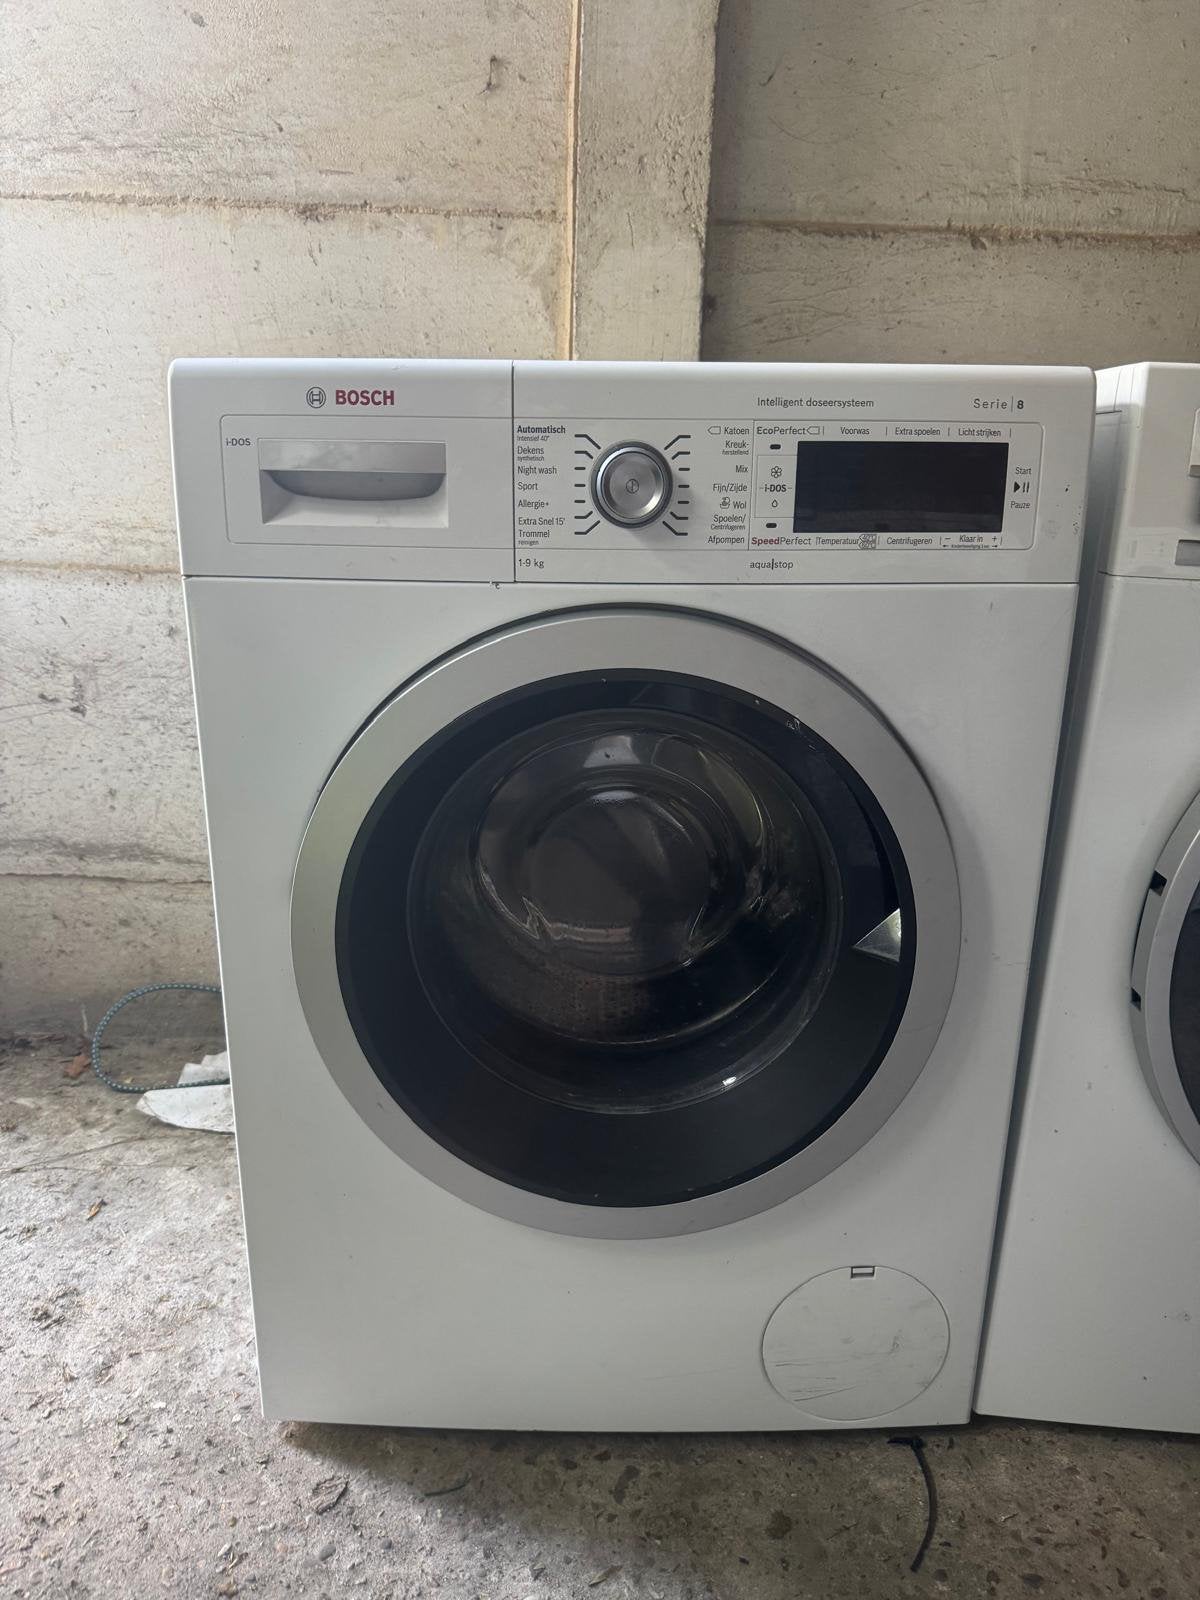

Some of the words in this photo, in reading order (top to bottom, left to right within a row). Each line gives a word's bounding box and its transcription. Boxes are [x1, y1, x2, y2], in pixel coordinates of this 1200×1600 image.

[335, 389, 395, 406] BOSCH
[757, 396, 804, 409] Intelligent
[805, 397, 874, 409] doseersysteem
[973, 398, 1008, 410] Serie
[1016, 399, 1025, 410] 8
[516, 425, 566, 434] Automatisch
[724, 426, 750, 435] Katoen
[756, 426, 806, 436] EcoPerfect
[840, 426, 870, 436] Voorwas
[894, 427, 913, 436] Extra
[913, 428, 941, 438] spoelen
[958, 428, 975, 437] Licht
[975, 429, 1002, 439] strijken
[226, 437, 251, 447] i-DOS
[725, 440, 750, 449] Kreuk-
[517, 446, 545, 455] Dekens
[517, 466, 537, 476] Night
[538, 466, 557, 475] wash
[735, 465, 749, 473] Mix
[1015, 467, 1032, 475] Start
[517, 481, 538, 491] Sport
[712, 483, 748, 493] Fijn/Zijde
[764, 484, 787, 493] i-DOS
[518, 499, 549, 510] Allergie+
[732, 501, 747, 510] Wol
[1010, 501, 1031, 509] Pauze
[518, 517, 536, 526] Extra
[537, 517, 554, 526] Snel
[713, 514, 747, 523] Spoelen/
[518, 530, 550, 538] Trommel
[959, 534, 976, 543] Klaar
[707, 536, 745, 545] Afpompen
[751, 536, 812, 546] SpeedPerfect
[818, 537, 859, 546] Temperatuur
[886, 537, 933, 546] Centrifugeren
[518, 558, 532, 568] 1-9
[533, 558, 545, 569] kg
